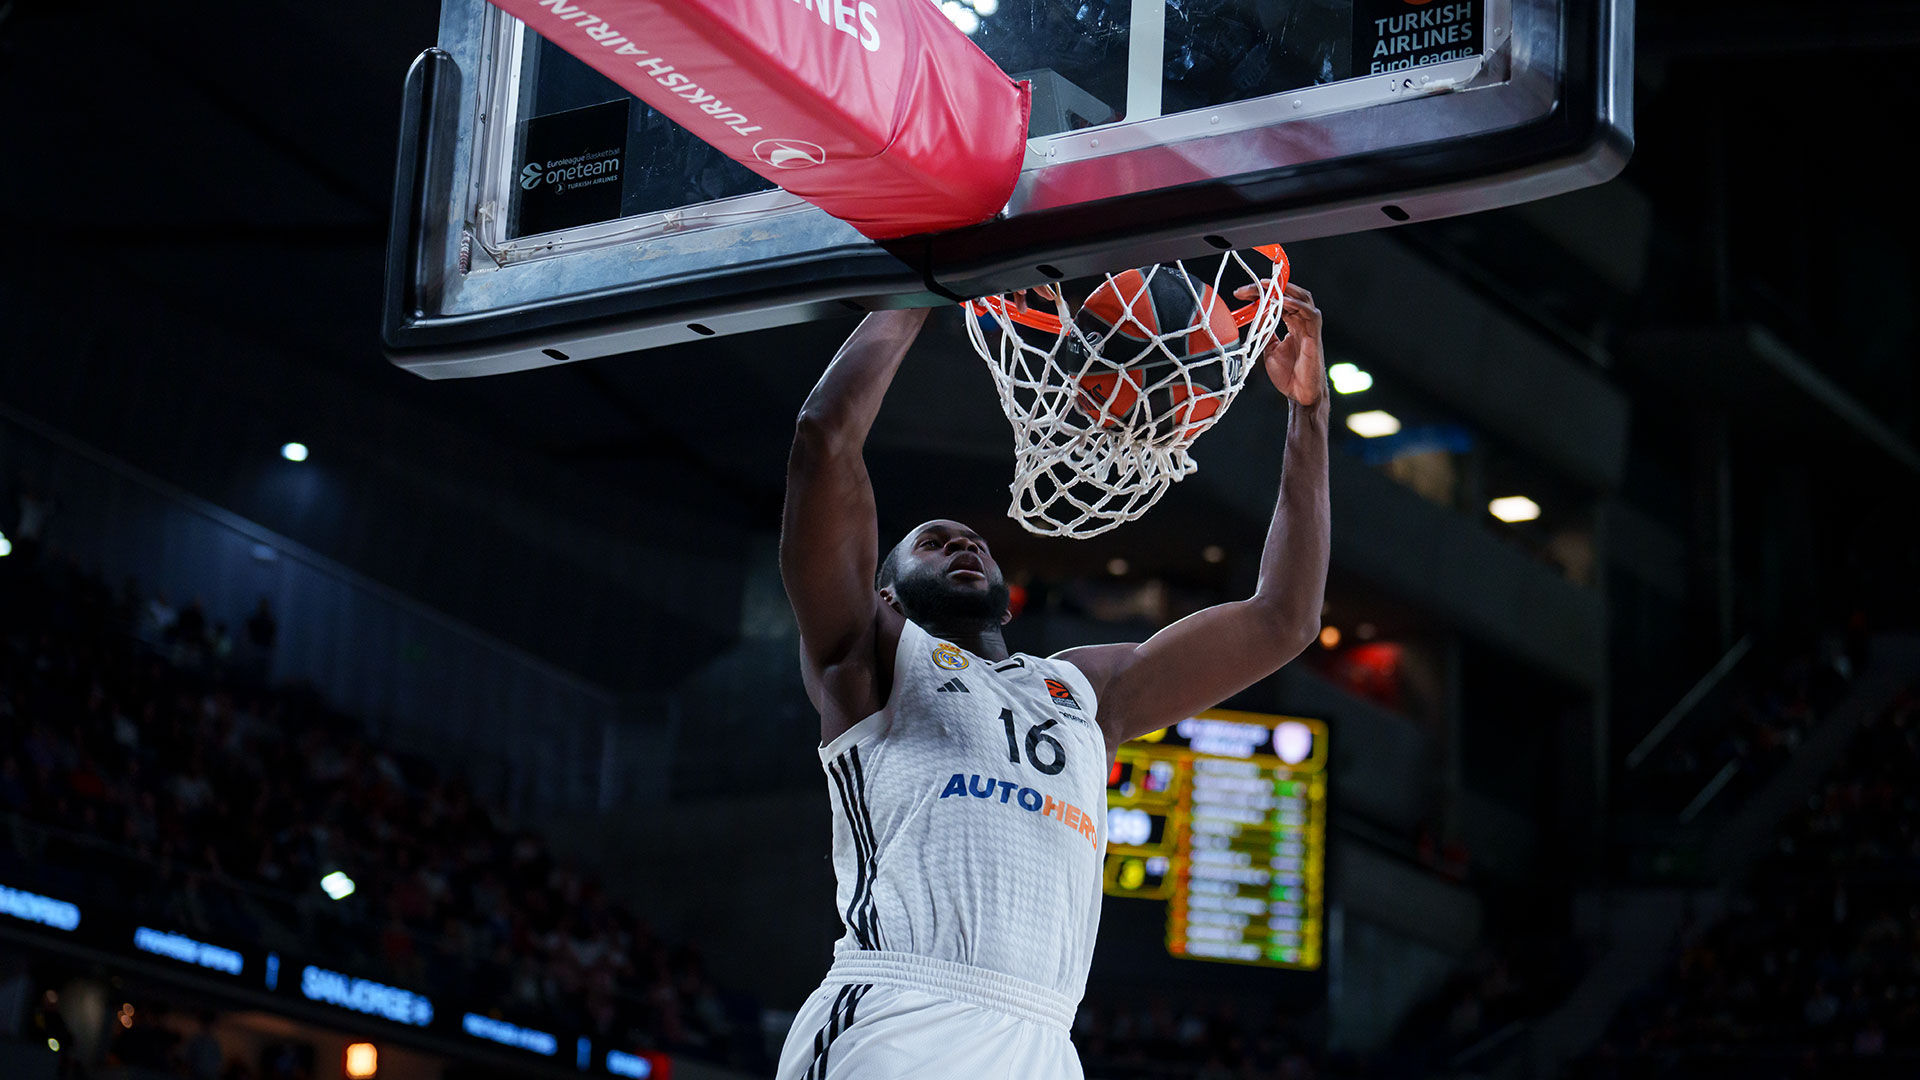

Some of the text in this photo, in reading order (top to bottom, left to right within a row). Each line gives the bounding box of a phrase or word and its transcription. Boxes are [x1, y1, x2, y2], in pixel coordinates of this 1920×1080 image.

[1374, 1, 1472, 37] TURKISH
[1372, 22, 1473, 59] AIRLINES
[1370, 46, 1474, 75] EuroLeague
[635, 57, 763, 136] TURKISH
[546, 158, 619, 184] oneteam
[547, 156, 585, 168] Euroleague
[568, 175, 618, 190] TURKISH AIRLINES
[998, 707, 1066, 776] 16
